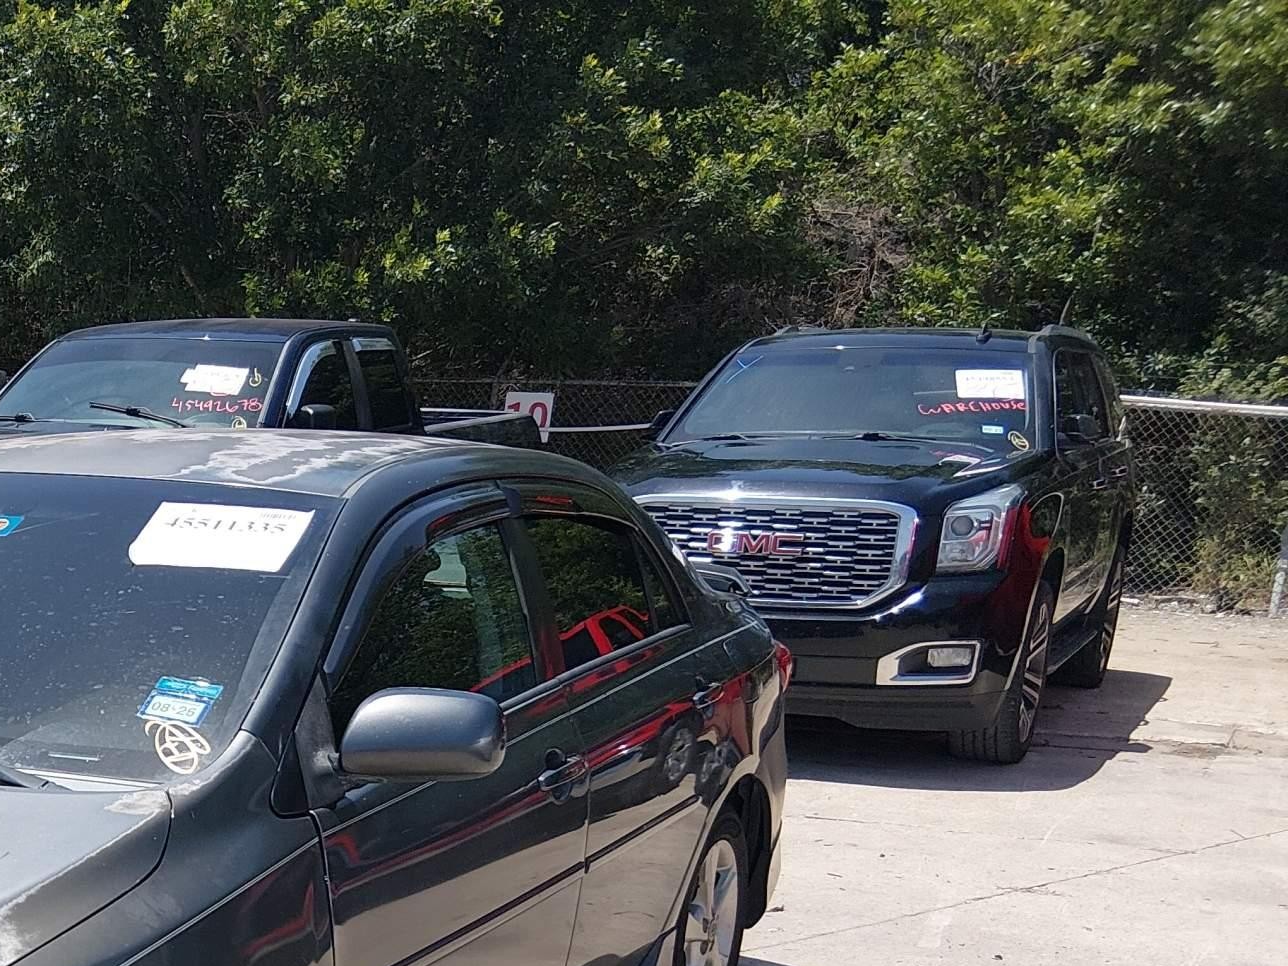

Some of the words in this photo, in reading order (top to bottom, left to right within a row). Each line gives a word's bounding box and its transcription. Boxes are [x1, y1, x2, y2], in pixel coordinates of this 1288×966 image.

[171, 397, 263, 413] 45492678
[164, 516, 289, 534] 45511335
[707, 529, 804, 555] GMC
